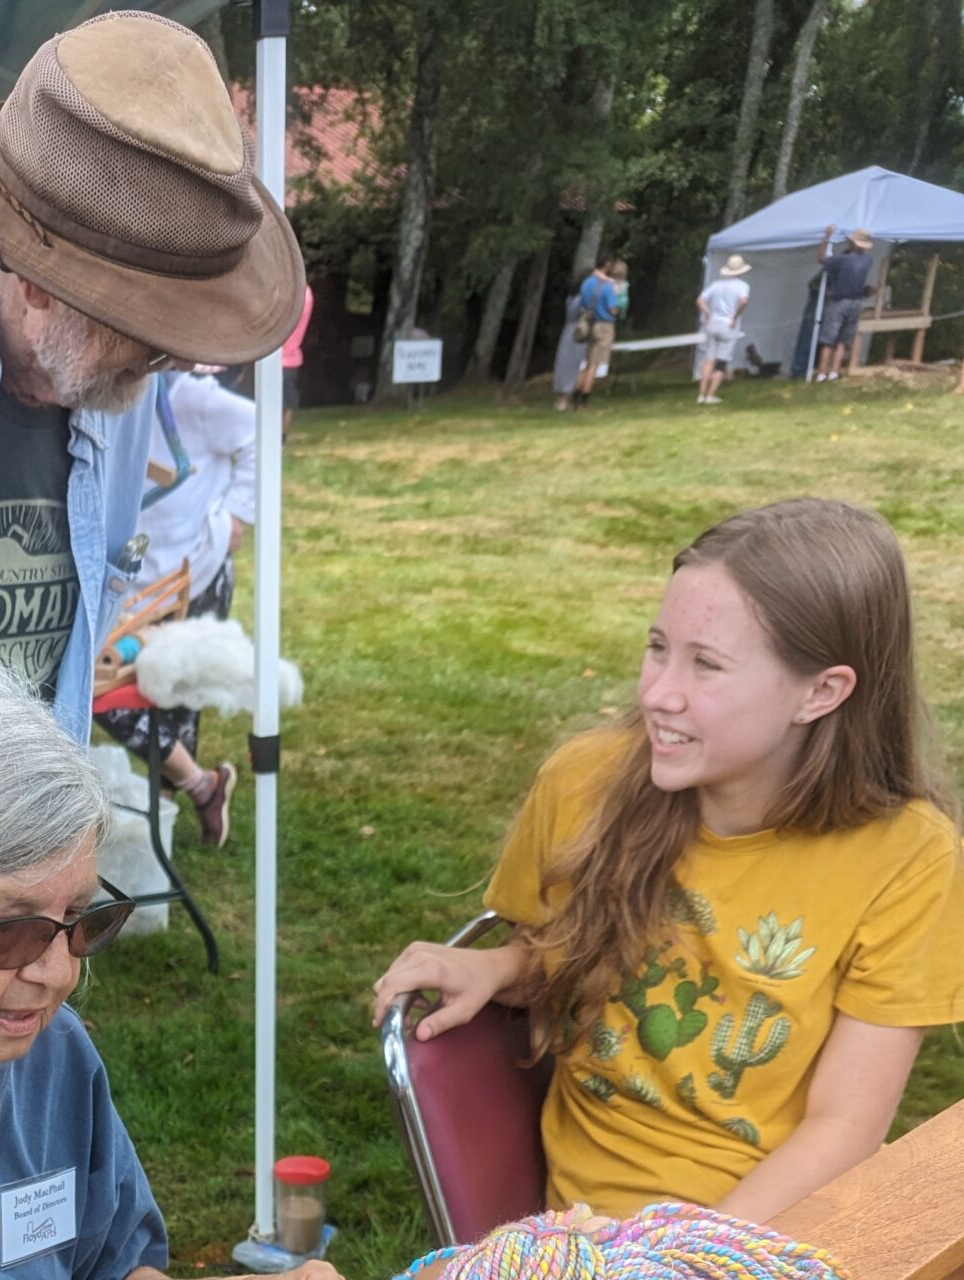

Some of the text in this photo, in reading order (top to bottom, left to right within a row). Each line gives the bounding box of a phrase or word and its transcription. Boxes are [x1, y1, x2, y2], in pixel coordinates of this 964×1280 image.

[14, 1180, 65, 1209] Judy MacPhail
[14, 1196, 67, 1220] Board of Directors
